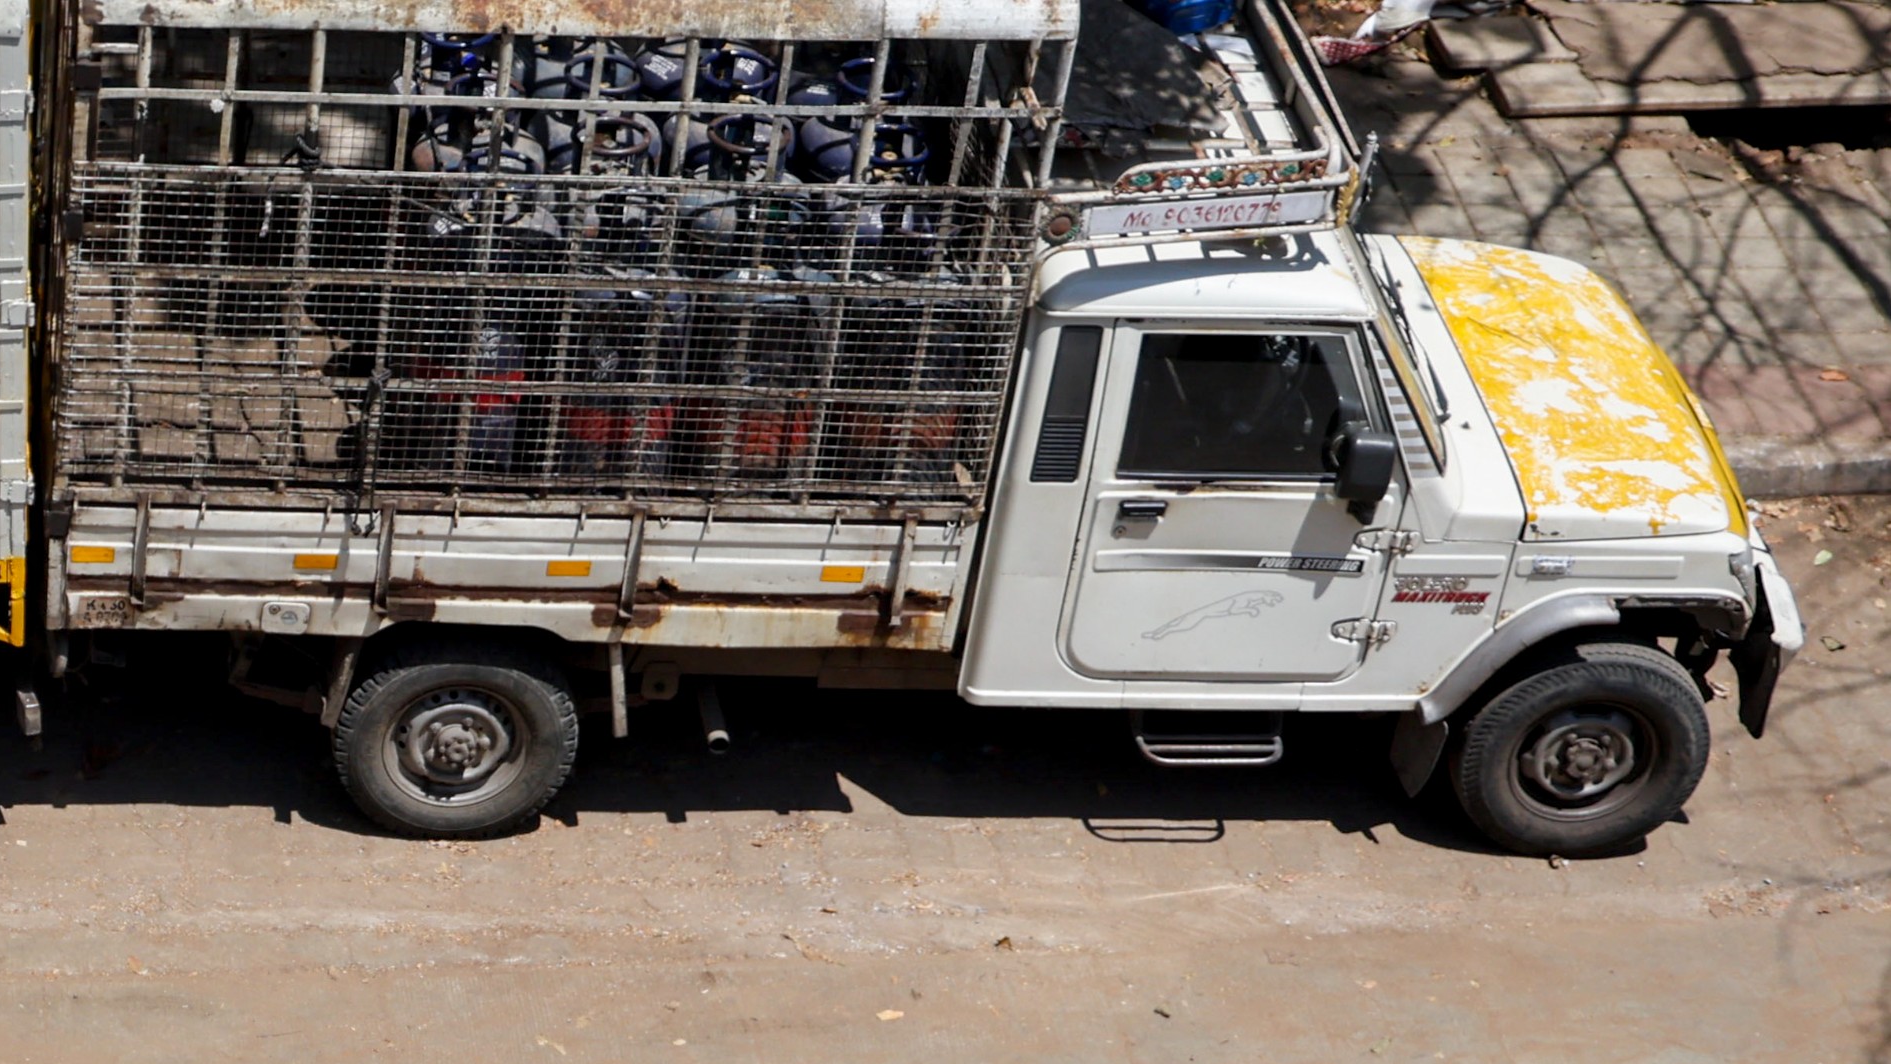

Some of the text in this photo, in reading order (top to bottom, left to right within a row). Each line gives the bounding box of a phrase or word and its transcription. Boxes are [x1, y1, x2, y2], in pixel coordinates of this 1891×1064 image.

[1258, 556, 1360, 571] POWER STEERING
[1393, 576, 1470, 592] BOLERO
[1391, 591, 1491, 603] MAXITRUCK
